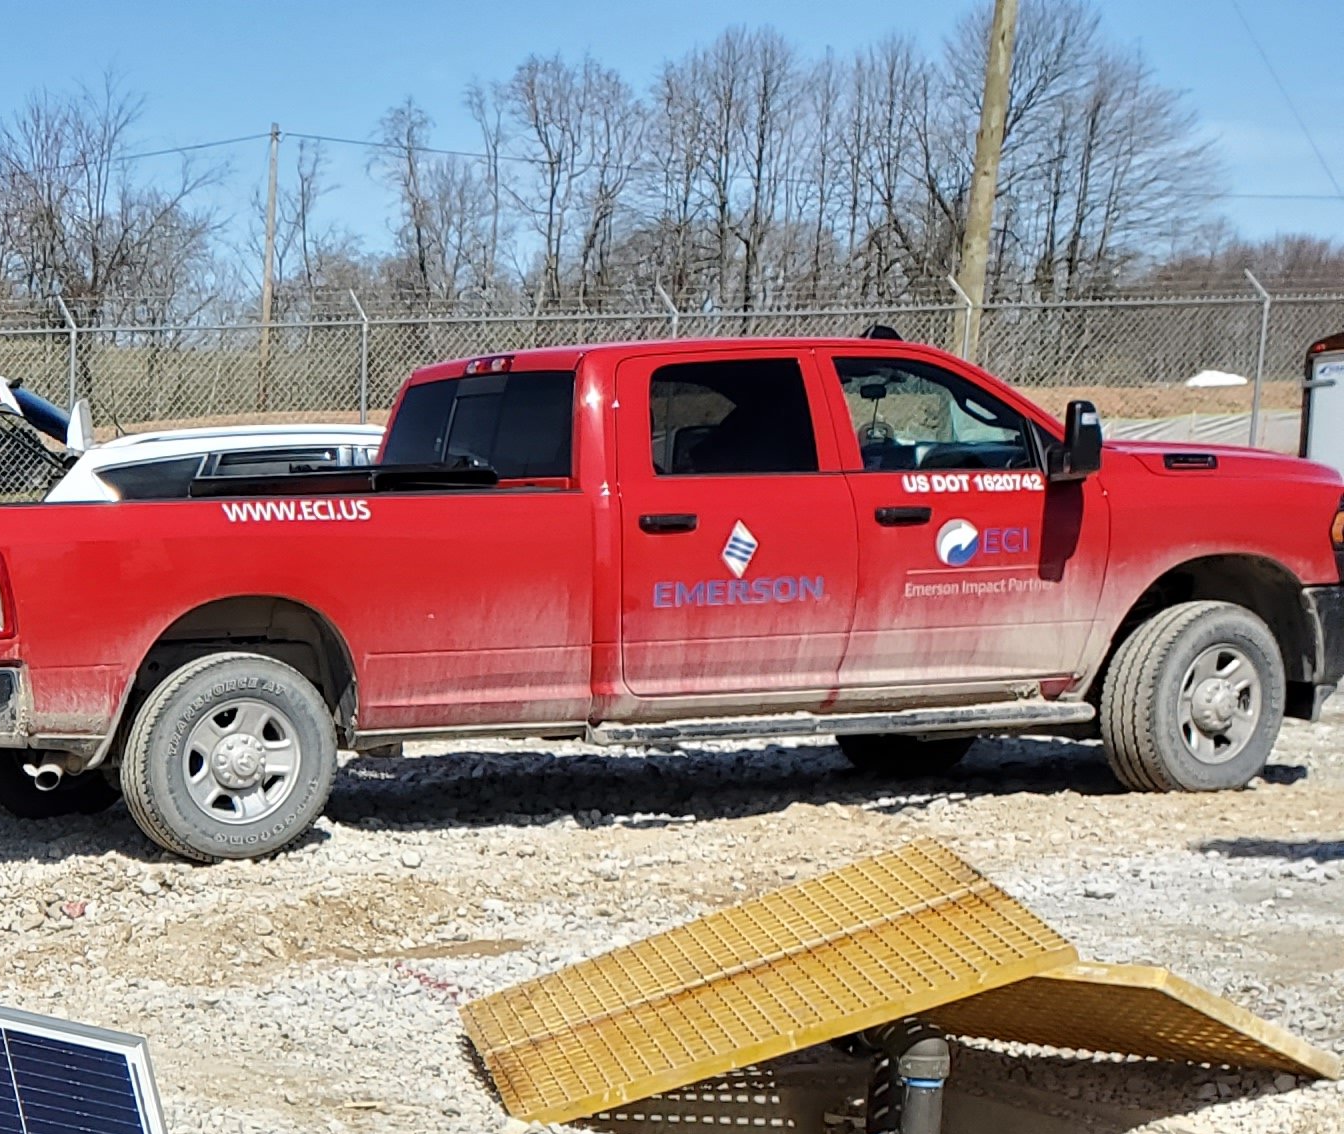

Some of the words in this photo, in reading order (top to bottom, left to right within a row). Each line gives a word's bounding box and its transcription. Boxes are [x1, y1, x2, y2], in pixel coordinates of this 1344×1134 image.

[902, 474, 930, 493] US
[932, 474, 970, 493] DOT
[972, 473, 1045, 492] 1620742
[221, 499, 372, 523] WWW.ECI.US
[983, 527, 1029, 554] ECI
[652, 575, 825, 609] EMERSON
[904, 582, 959, 598] Emerson
[962, 579, 1006, 597] Impact
[1008, 577, 1055, 593] Partner
